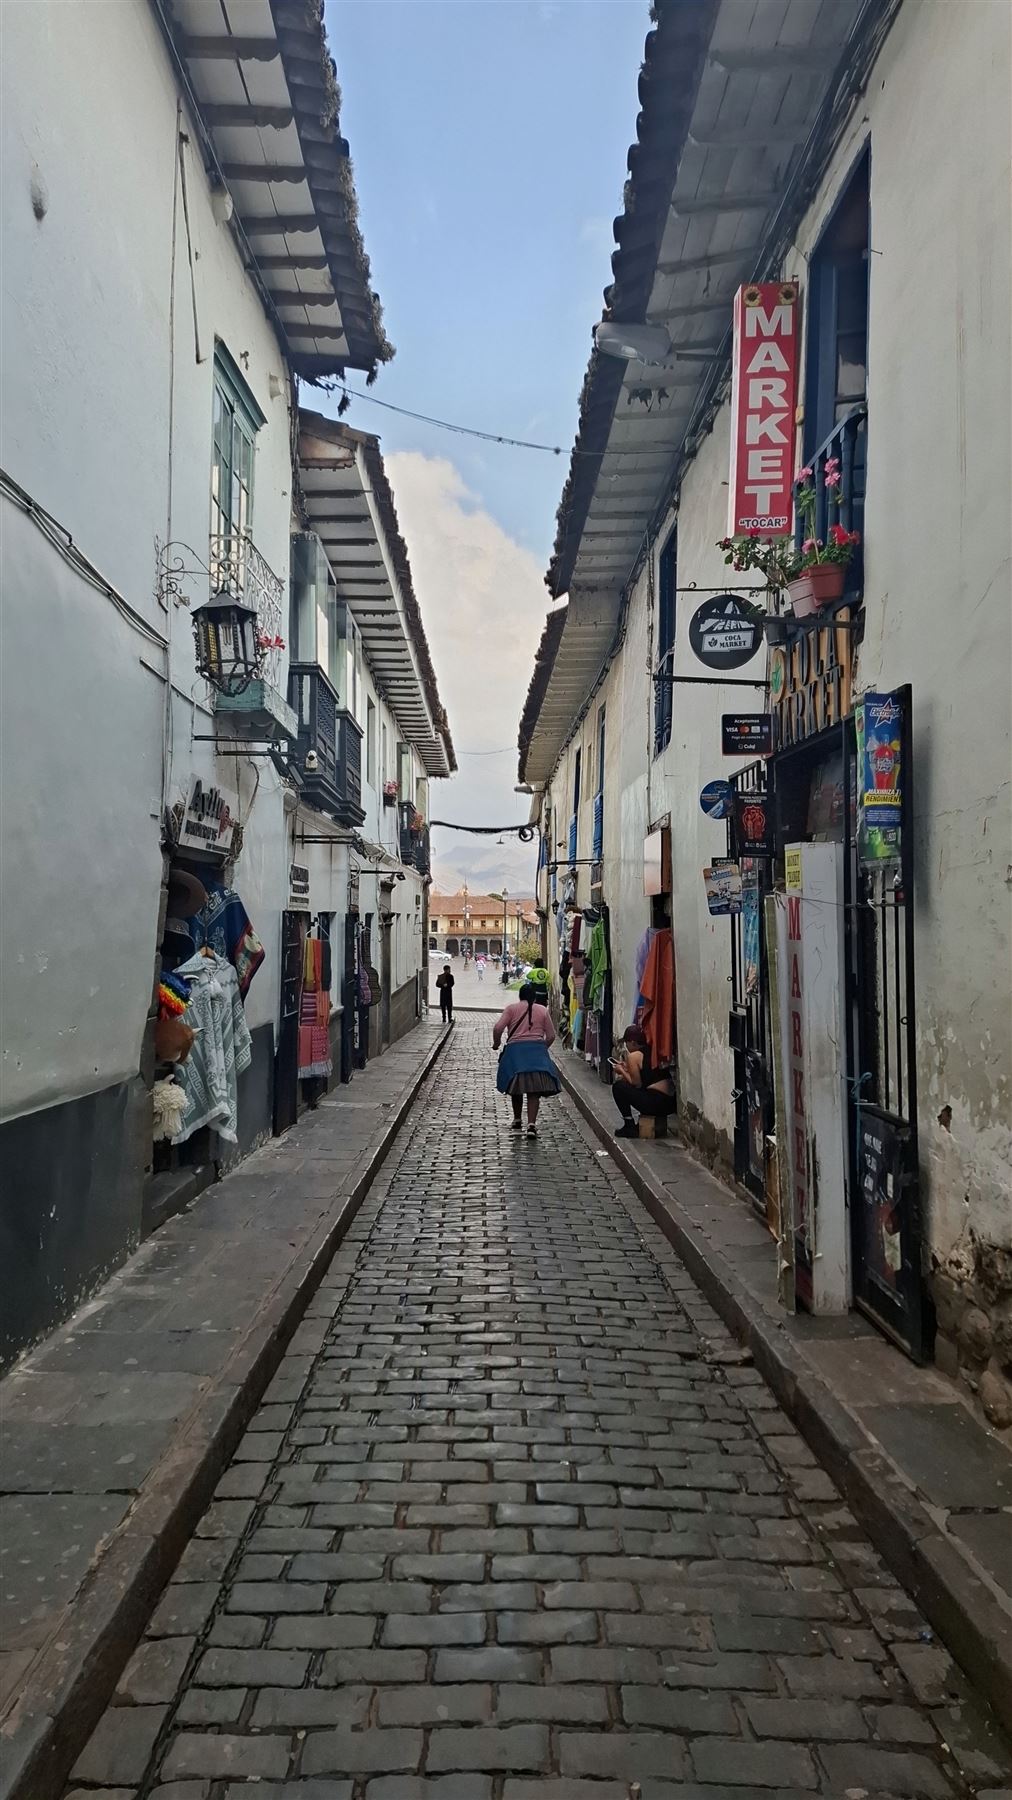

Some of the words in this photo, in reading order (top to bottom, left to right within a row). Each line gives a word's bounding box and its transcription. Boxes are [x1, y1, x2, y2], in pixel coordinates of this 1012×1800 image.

[744, 304, 793, 516] MARKET
[724, 634, 741, 642] COCA
[719, 640, 747, 648] MARKET
[771, 664, 842, 750] MARKET
[867, 788, 895, 796] MAXIMIZA
[865, 795, 902, 803] RENDIMIENT
[788, 897, 806, 1236] MARKET
